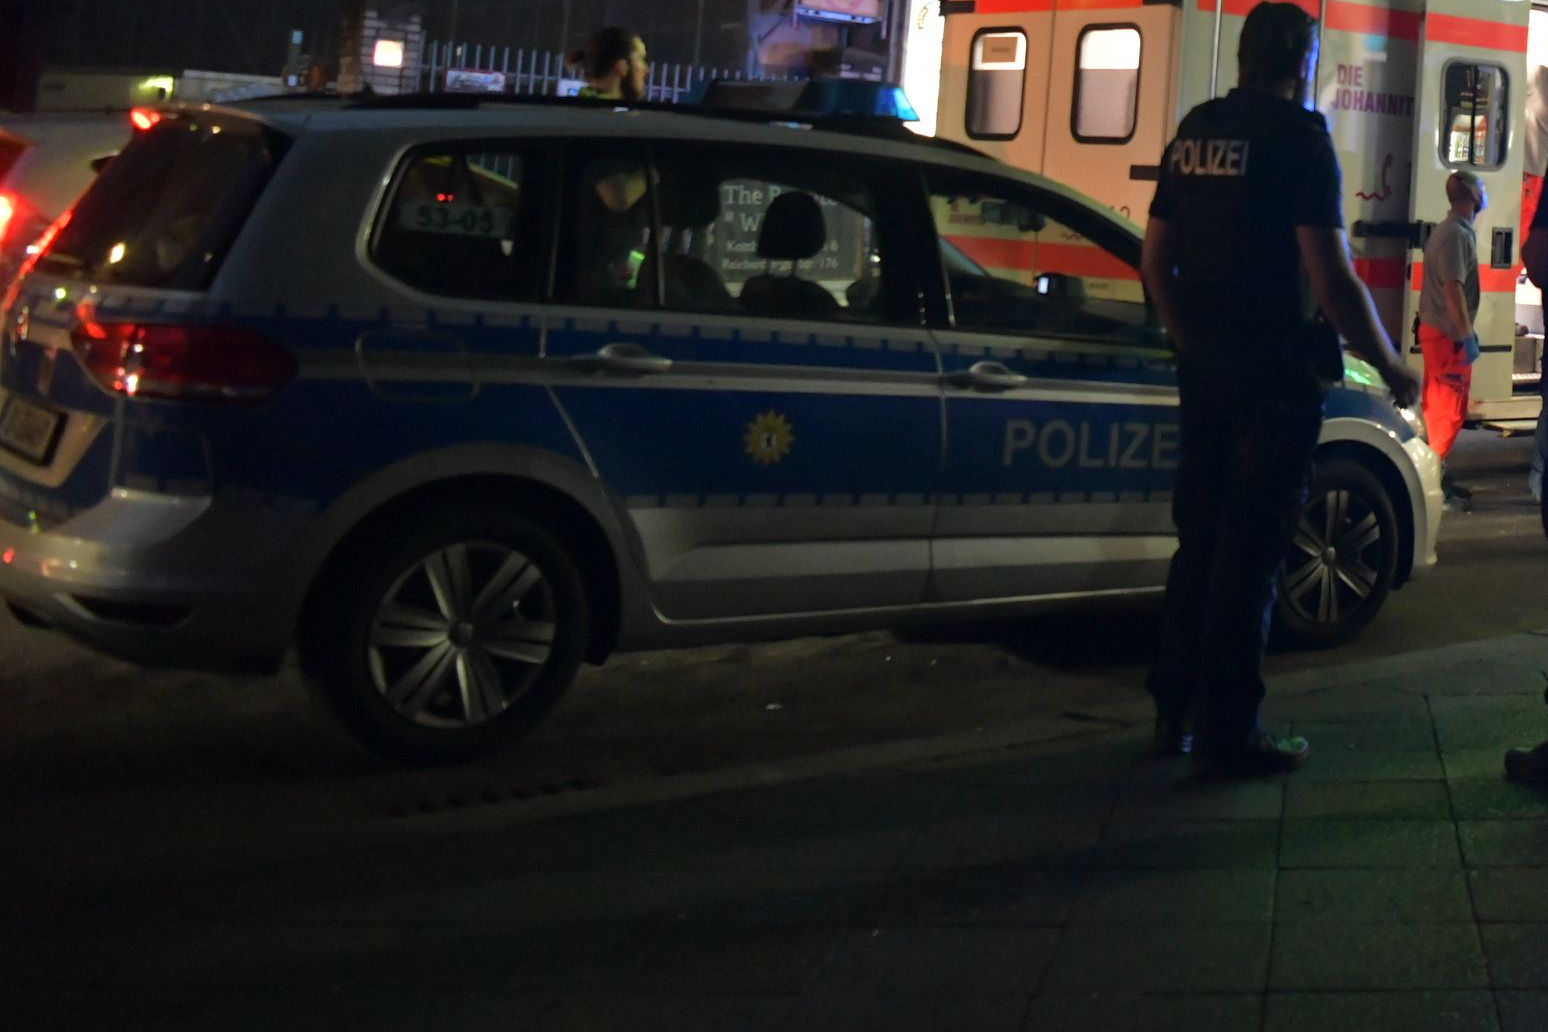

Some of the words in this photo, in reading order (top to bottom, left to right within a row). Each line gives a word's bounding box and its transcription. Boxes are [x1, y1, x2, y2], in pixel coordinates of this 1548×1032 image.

[1337, 64, 1363, 87] DIE
[1332, 87, 1414, 118] JOHANNIT
[1168, 138, 1250, 176] POLIZEI
[724, 184, 763, 206] The
[1002, 418, 1180, 468] POLIZE
